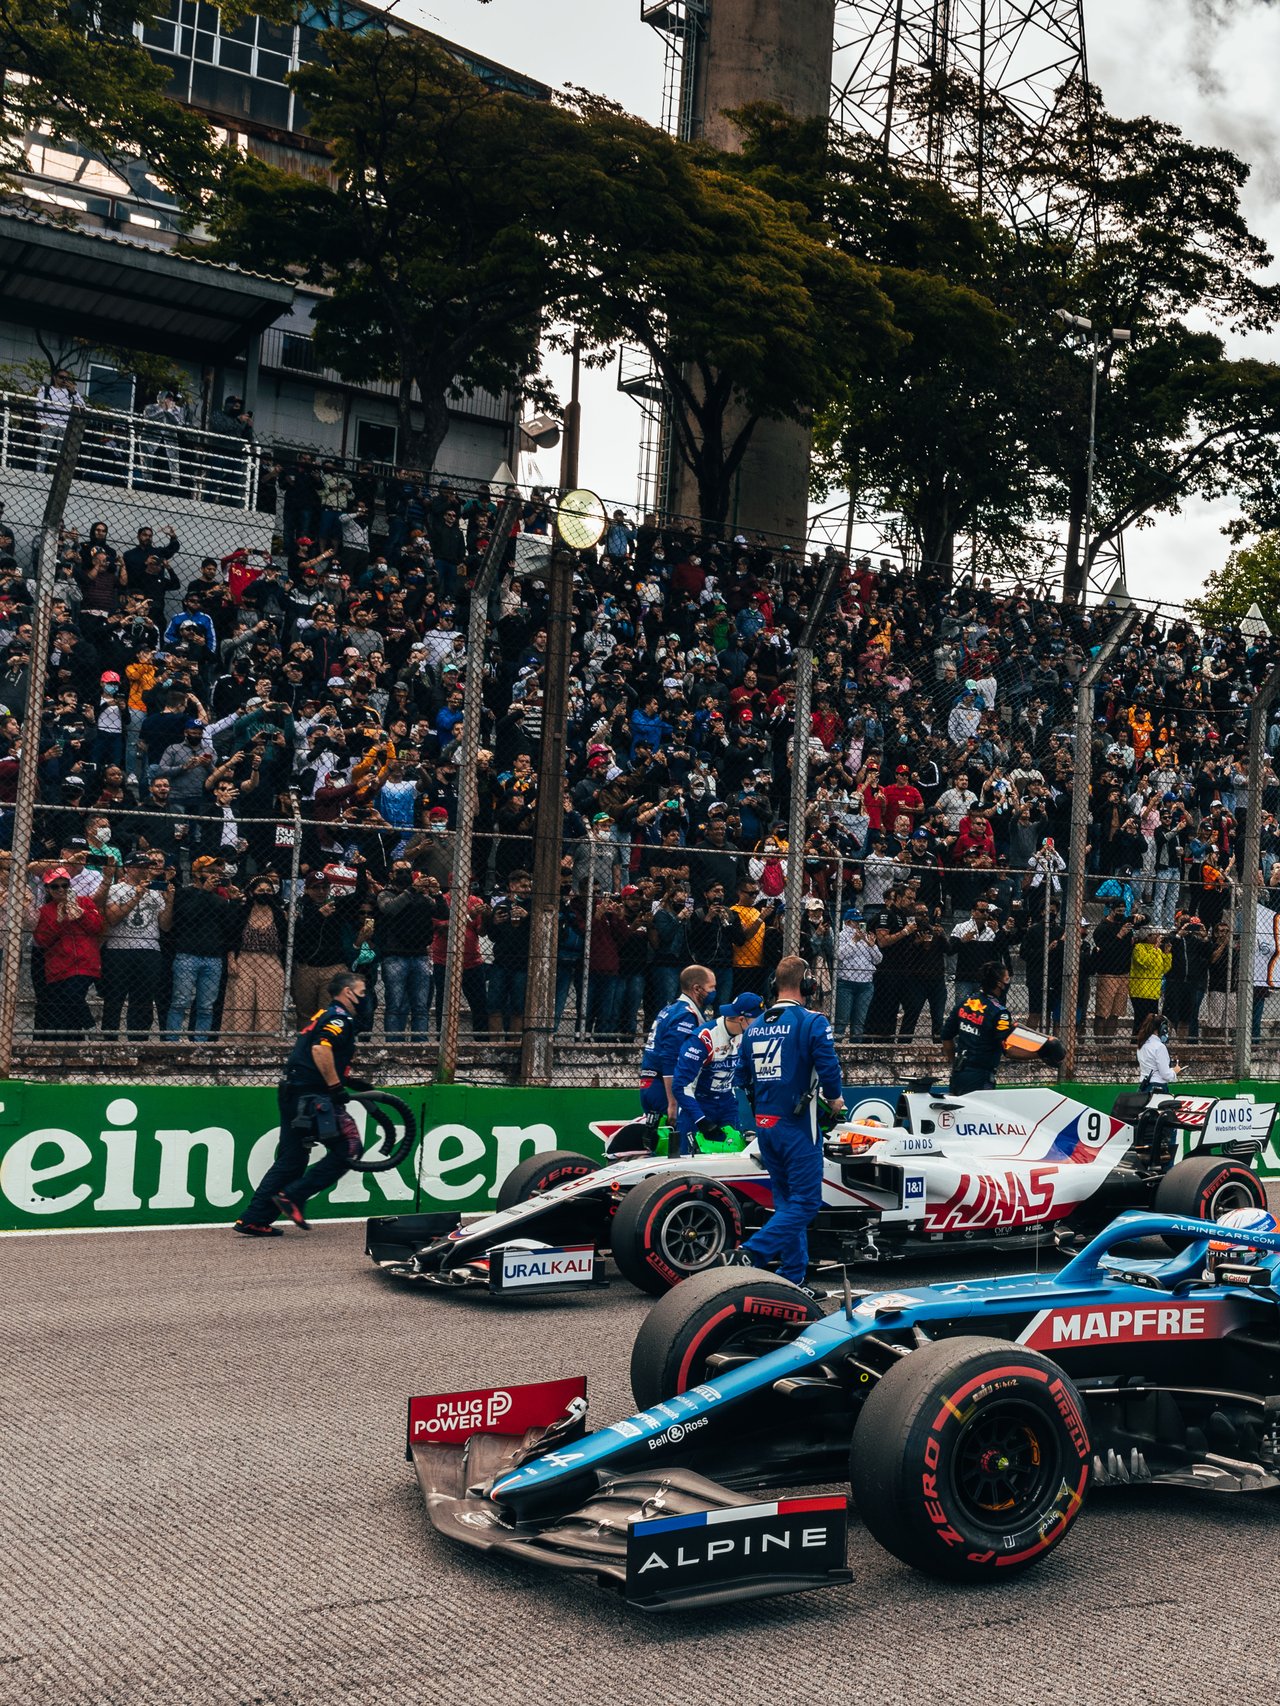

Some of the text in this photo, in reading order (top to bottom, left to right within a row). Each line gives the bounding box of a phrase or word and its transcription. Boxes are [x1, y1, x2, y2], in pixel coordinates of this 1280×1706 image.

[747, 1024, 791, 1037] URALKALI
[1087, 1112, 1101, 1142] 9
[1215, 1107, 1253, 1124] IONOS
[956, 1122, 1028, 1137] URALKALI
[902, 1138, 934, 1151] IONOS
[0, 1098, 558, 1215] eineken
[537, 1166, 589, 1190] ZERO
[906, 1180, 923, 1194] 1&1
[1171, 1223, 1276, 1246] ALPINECARS.COM
[504, 1258, 592, 1279] URALKALI
[743, 1295, 808, 1323] PIRELLI
[1052, 1307, 1205, 1344] MAPFRE
[436, 1399, 483, 1417] PLUG
[1049, 1378, 1091, 1460] PIRELLI
[414, 1414, 482, 1435] POWER
[648, 1434, 668, 1450] Bell
[684, 1416, 709, 1434] Ross
[922, 1436, 966, 1547] ZERO
[637, 1527, 827, 1574] ALPINE
